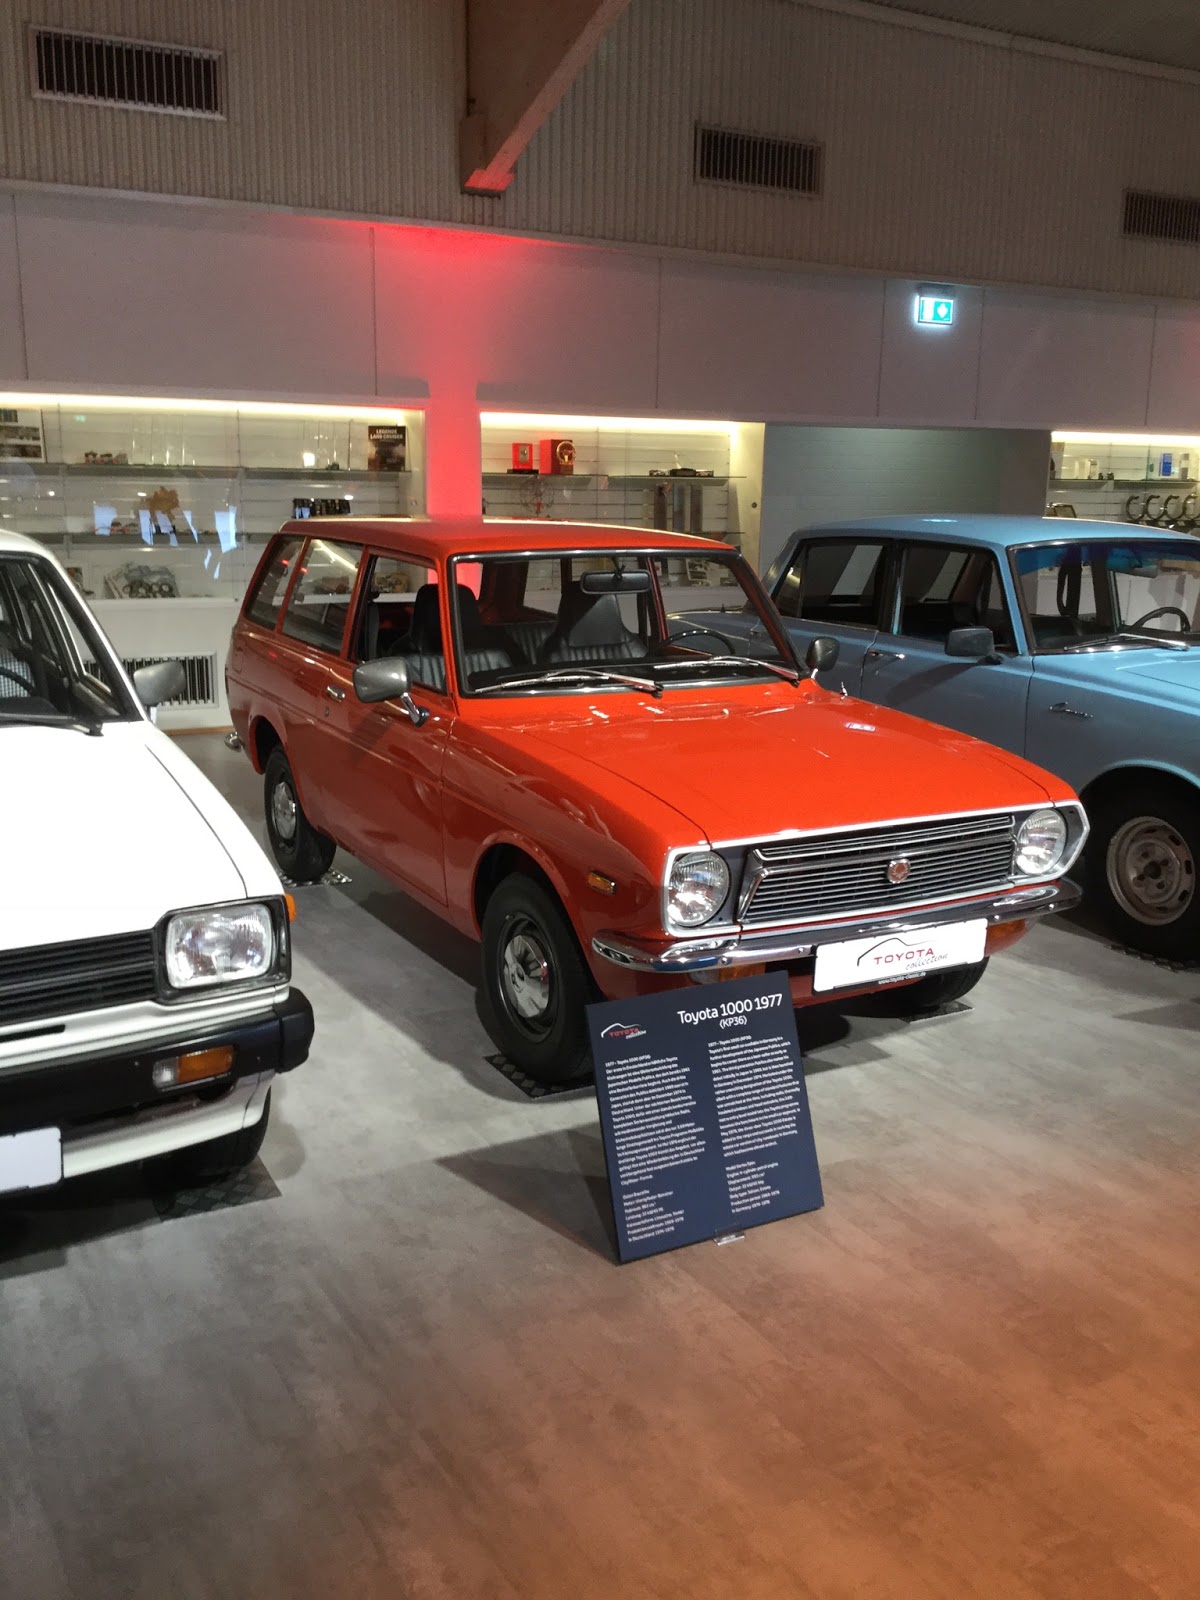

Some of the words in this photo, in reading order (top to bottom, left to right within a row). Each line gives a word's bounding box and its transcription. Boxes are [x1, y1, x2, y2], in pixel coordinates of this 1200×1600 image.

[873, 948, 934, 965] TOYOTA
[906, 953, 948, 970] collection
[677, 1008, 718, 1025] Toyota
[720, 999, 753, 1016] 1000
[754, 993, 782, 1010] 1977
[720, 1015, 748, 1030] (KP36)
[609, 1028, 639, 1038] TOYOTA
